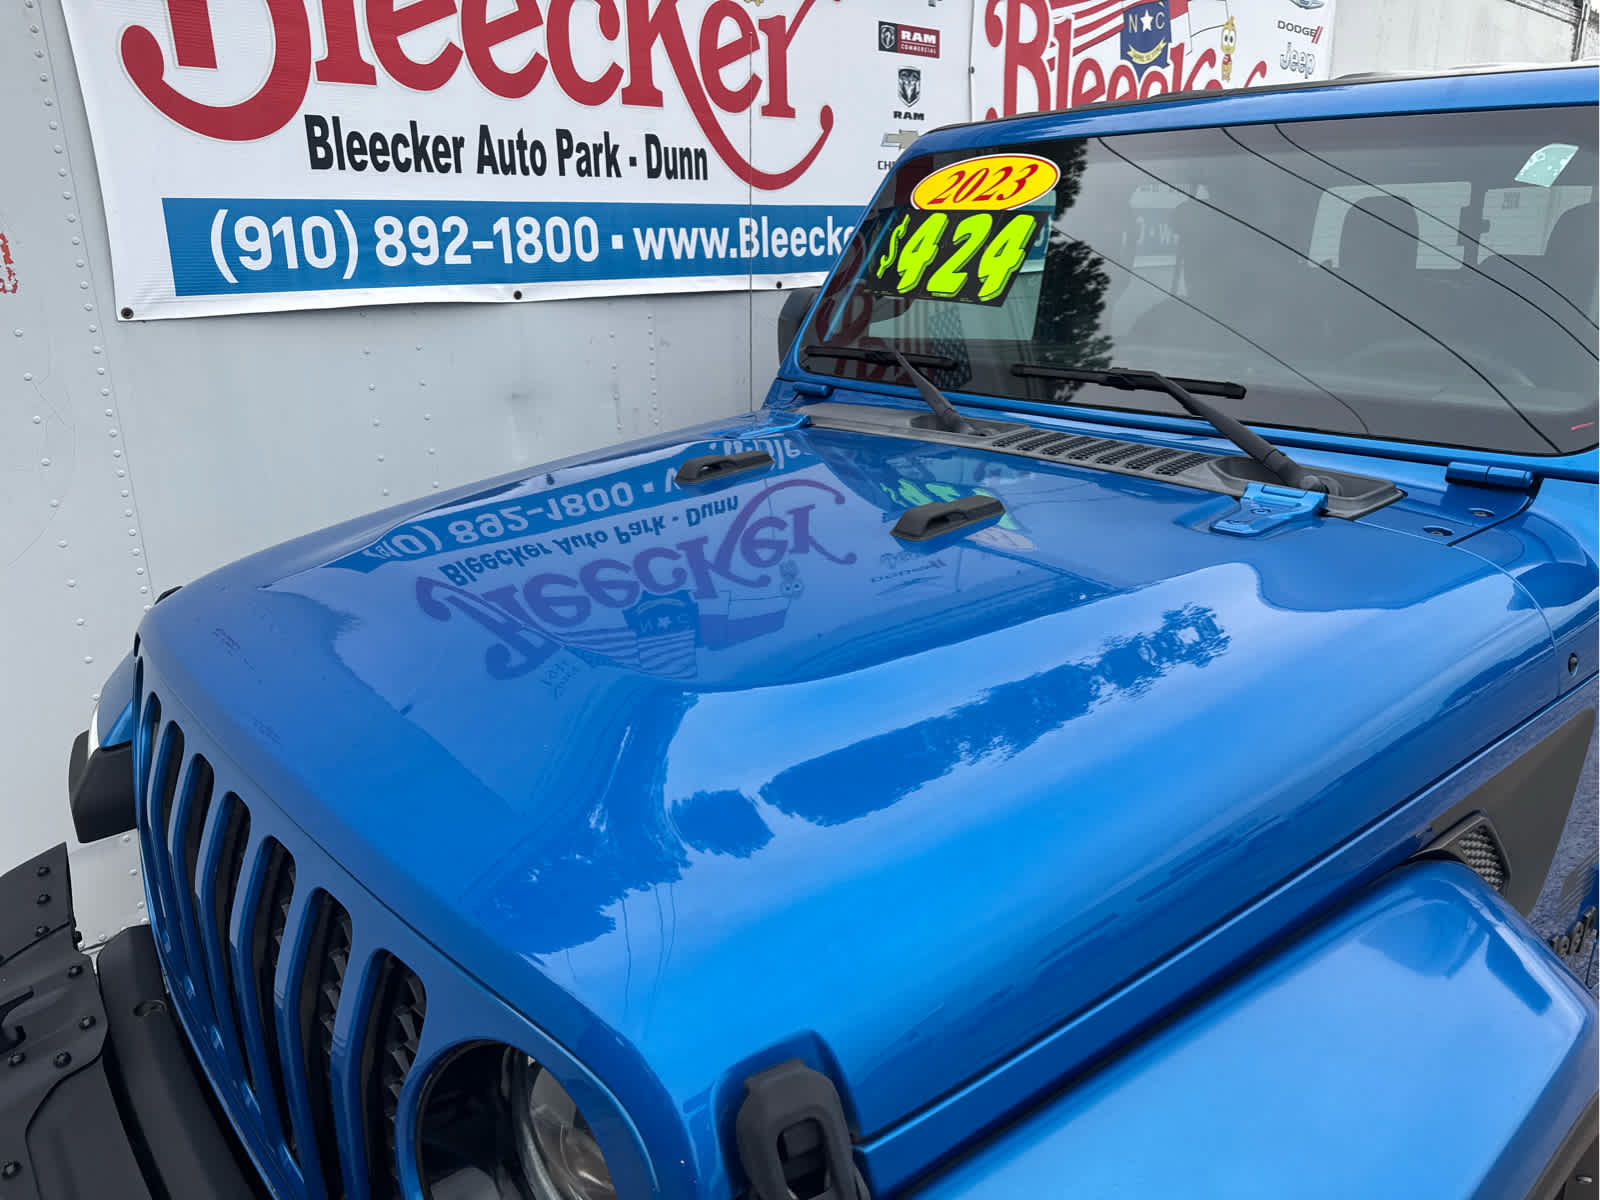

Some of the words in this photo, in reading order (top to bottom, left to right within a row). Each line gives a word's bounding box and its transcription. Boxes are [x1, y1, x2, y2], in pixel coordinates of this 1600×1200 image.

[901, 30, 936, 44] RAM
[1128, 14, 1138, 33] N
[1155, 11, 1165, 30] C
[1277, 20, 1317, 37] DODGE
[984, 0, 1267, 119] Bleek
[1280, 41, 1316, 79] Jeep
[893, 110, 925, 121] RAM
[304, 114, 465, 174] Bleecker
[476, 124, 547, 177] Auto
[556, 128, 622, 178] Park
[645, 133, 708, 181] Dunn
[927, 163, 1039, 205] 2023
[210, 209, 359, 284] (910)
[373, 215, 600, 268] 892-1800
[876, 212, 1037, 303] $424
